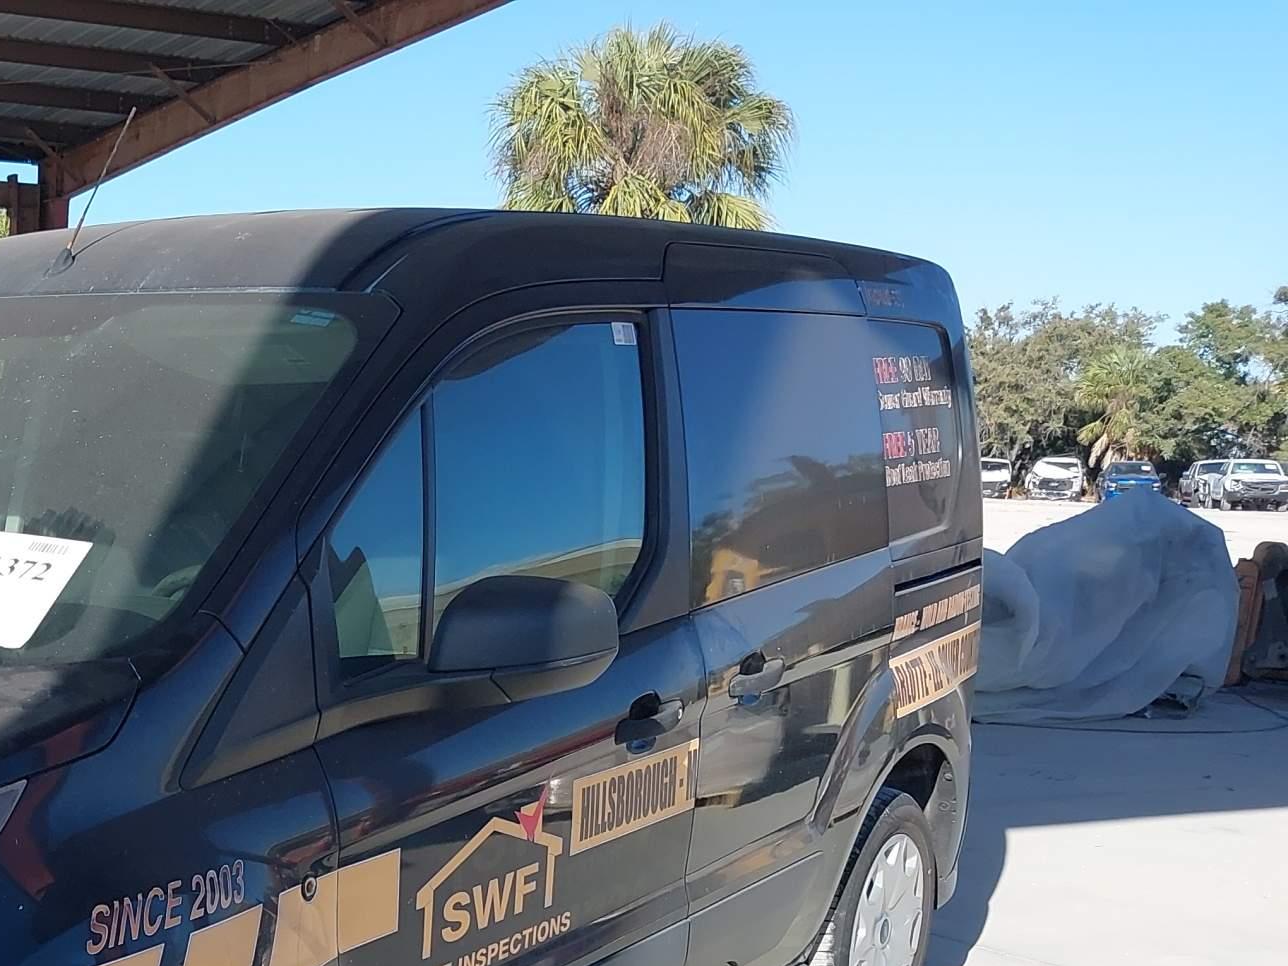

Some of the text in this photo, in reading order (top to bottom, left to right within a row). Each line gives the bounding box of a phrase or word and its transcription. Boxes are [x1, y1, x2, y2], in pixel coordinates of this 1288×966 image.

[579, 756, 677, 842] HILLSBOROUGH
[86, 859, 245, 955] SINCE 2003
[441, 862, 540, 943] SWF
